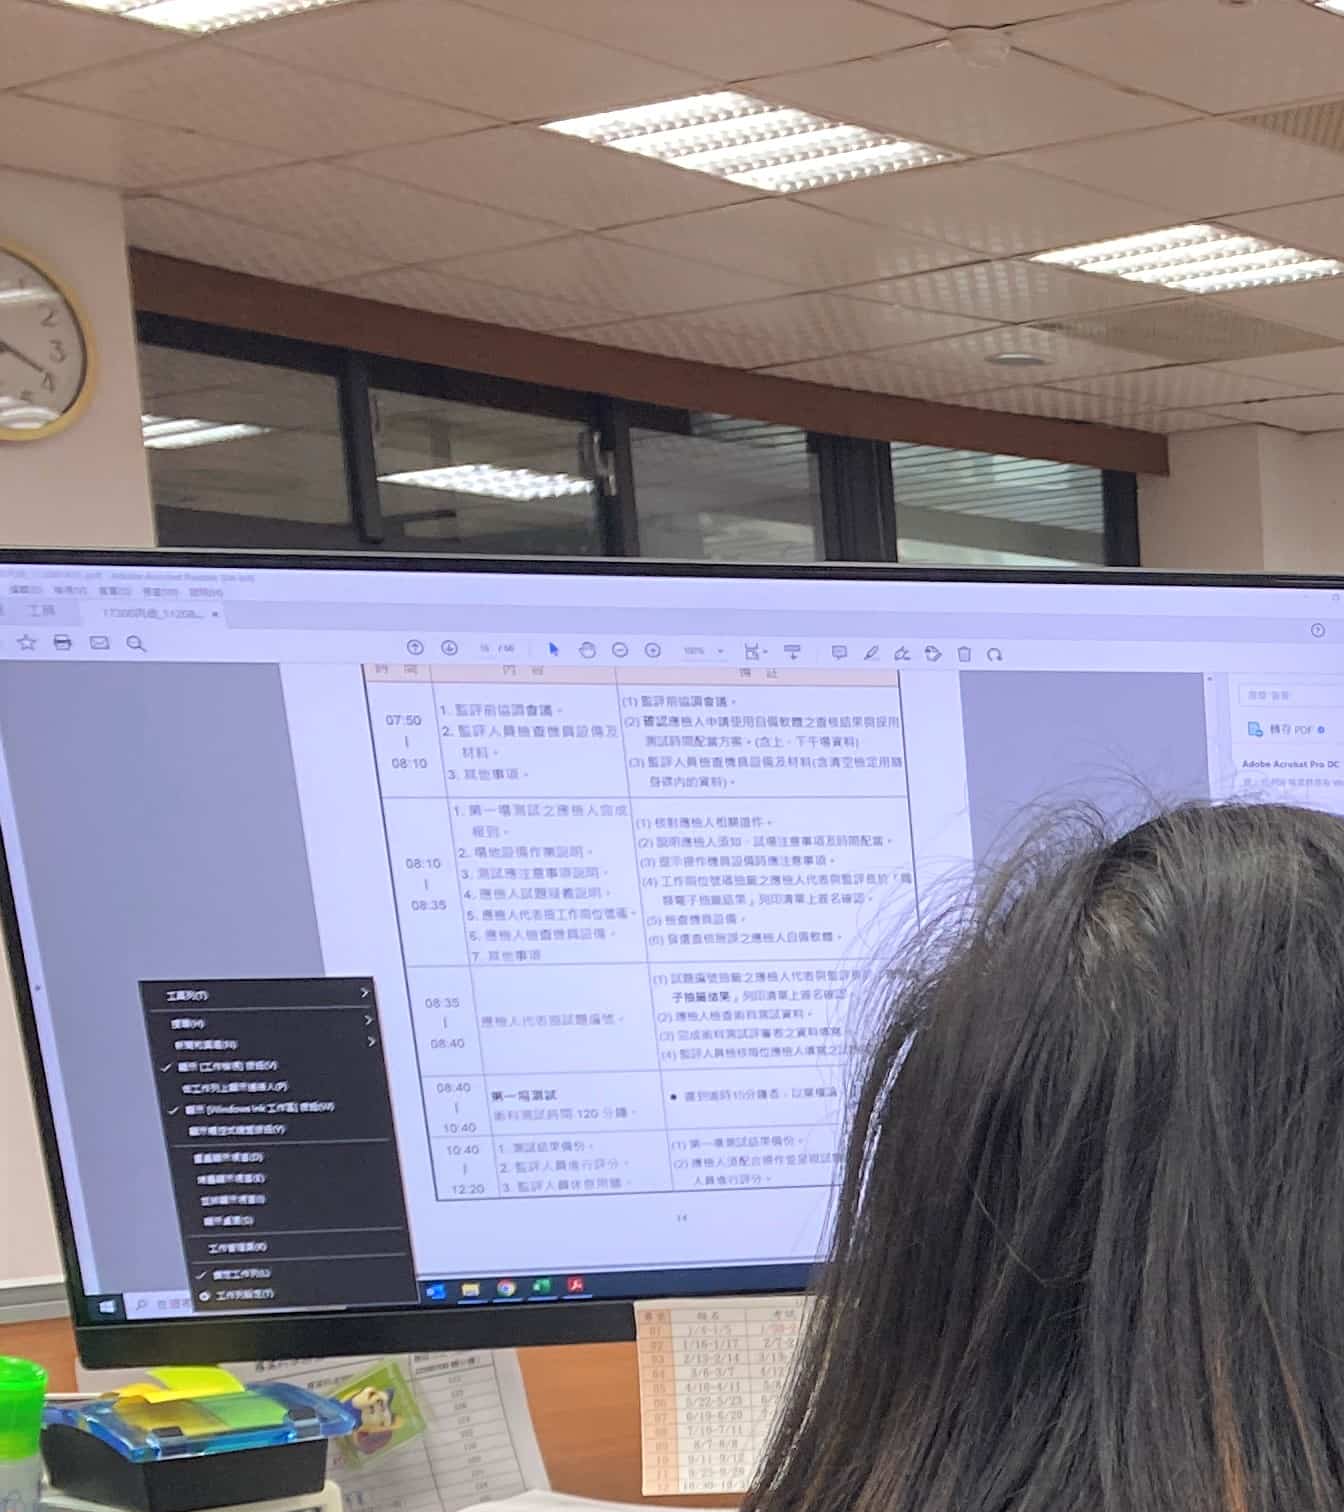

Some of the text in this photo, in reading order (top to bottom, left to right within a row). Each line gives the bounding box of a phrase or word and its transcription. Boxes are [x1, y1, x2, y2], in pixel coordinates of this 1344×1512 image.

[385, 714, 422, 726] 07:50
[391, 757, 428, 769] 08:10
[405, 858, 442, 870] 08:10
[411, 900, 447, 911] 08:35
[425, 998, 460, 1009] 08:35
[430, 1038, 465, 1049] 08:40
[436, 1082, 471, 1093] 08:40
[577, 1108, 600, 1119] 120
[444, 1122, 477, 1134] 10:40
[447, 1144, 480, 1155] 10:40
[452, 1183, 485, 1195] 12:20
